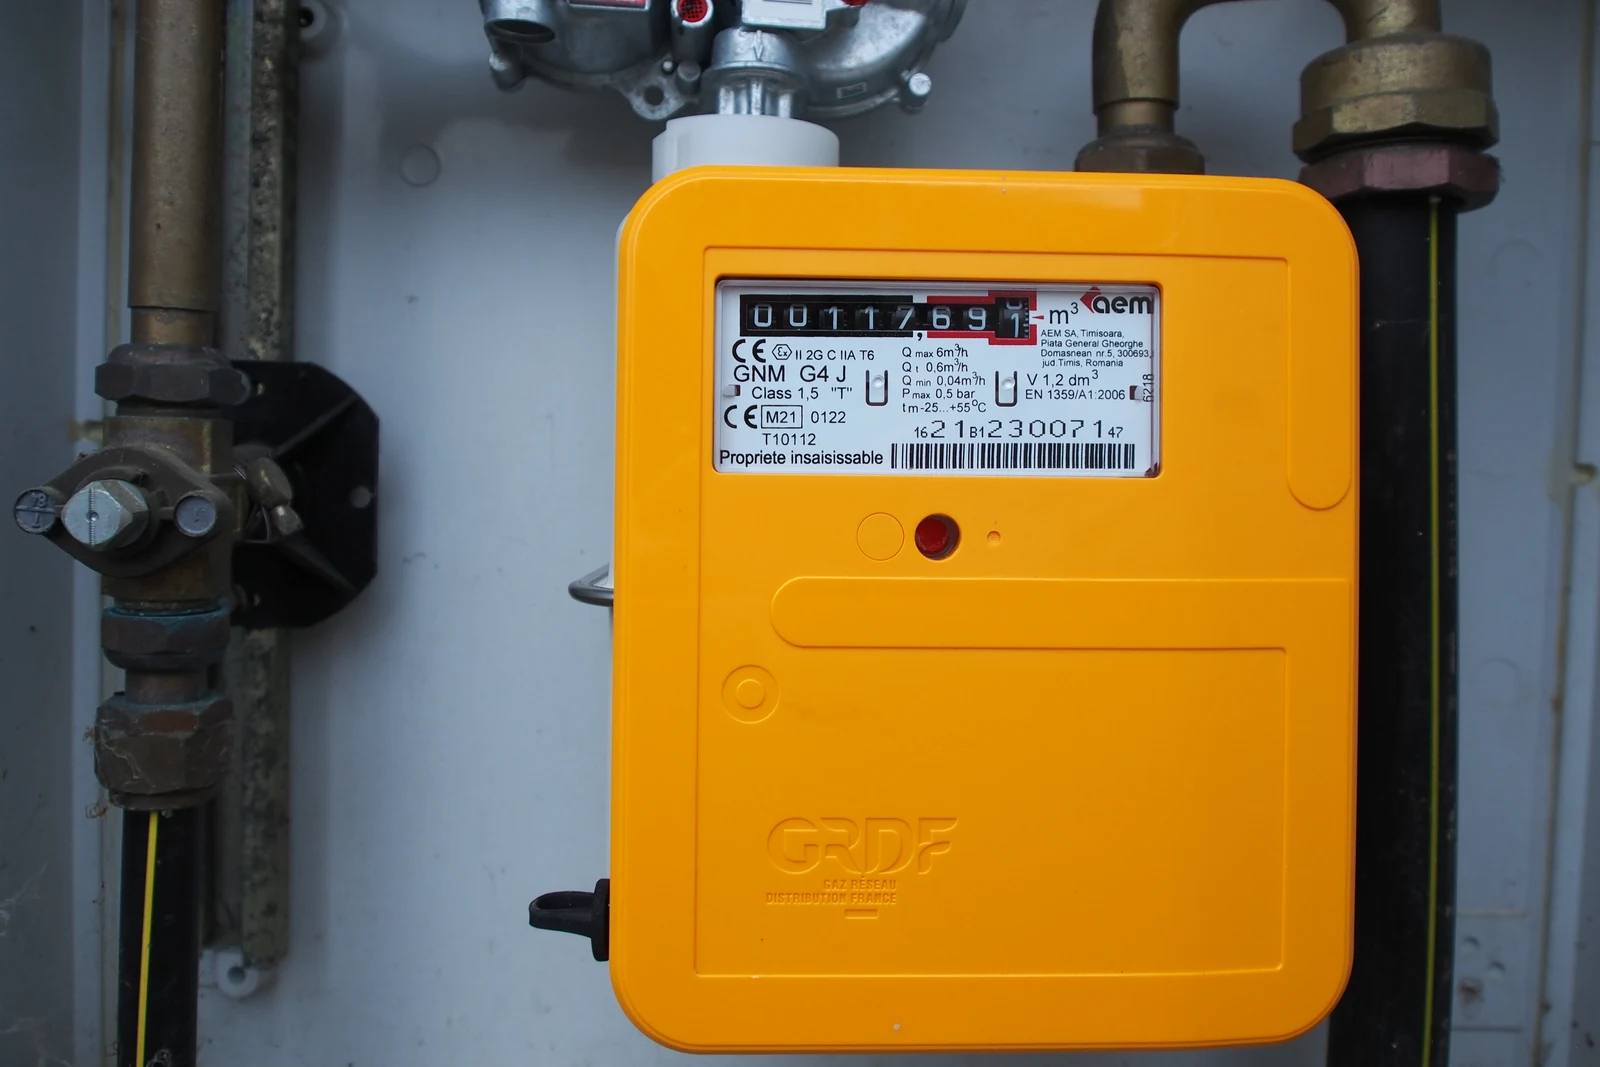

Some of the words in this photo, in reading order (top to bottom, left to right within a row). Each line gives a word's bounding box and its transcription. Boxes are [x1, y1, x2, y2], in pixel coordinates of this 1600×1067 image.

[1092, 295, 1152, 314] aem
[1041, 330, 1062, 338] AEM
[1064, 330, 1079, 339] SA,
[1081, 329, 1124, 339] Timisoara,
[1041, 339, 1063, 348] Piata
[1065, 339, 1099, 348] General
[1102, 339, 1144, 350] Gheorghe
[806, 349, 823, 360] 2G
[827, 349, 836, 360] C
[860, 349, 875, 360] T6
[902, 346, 912, 358] Q
[1041, 349, 1092, 358] Domasnean
[1096, 349, 1115, 359] nr.5,
[902, 361, 912, 373] Q
[1086, 359, 1124, 367] Romania
[734, 365, 785, 382] GNM
[800, 365, 829, 382] G4
[836, 365, 847, 382] J
[902, 375, 912, 386] Q
[1026, 374, 1038, 386] V
[1043, 374, 1064, 389] 1,2
[751, 386, 792, 399] Class
[798, 387, 819, 402] 1,5
[831, 386, 853, 399] "T"
[902, 389, 911, 399] P
[935, 389, 953, 400] 0,5
[956, 388, 976, 399] bar
[1026, 390, 1043, 400] EN
[1047, 389, 1126, 400] 1359/A1:2006
[766, 411, 796, 424] M21
[811, 411, 846, 424] 0122
[762, 433, 816, 446] T10112
[720, 450, 786, 466] Propriete
[791, 450, 883, 465] insaisissable
[766, 816, 958, 875] GRDF
[823, 879, 847, 891] GAZ
[851, 876, 897, 891] RÉSEAU
[765, 893, 847, 905] DISTRIBUTION
[851, 893, 897, 905] FRANCE
